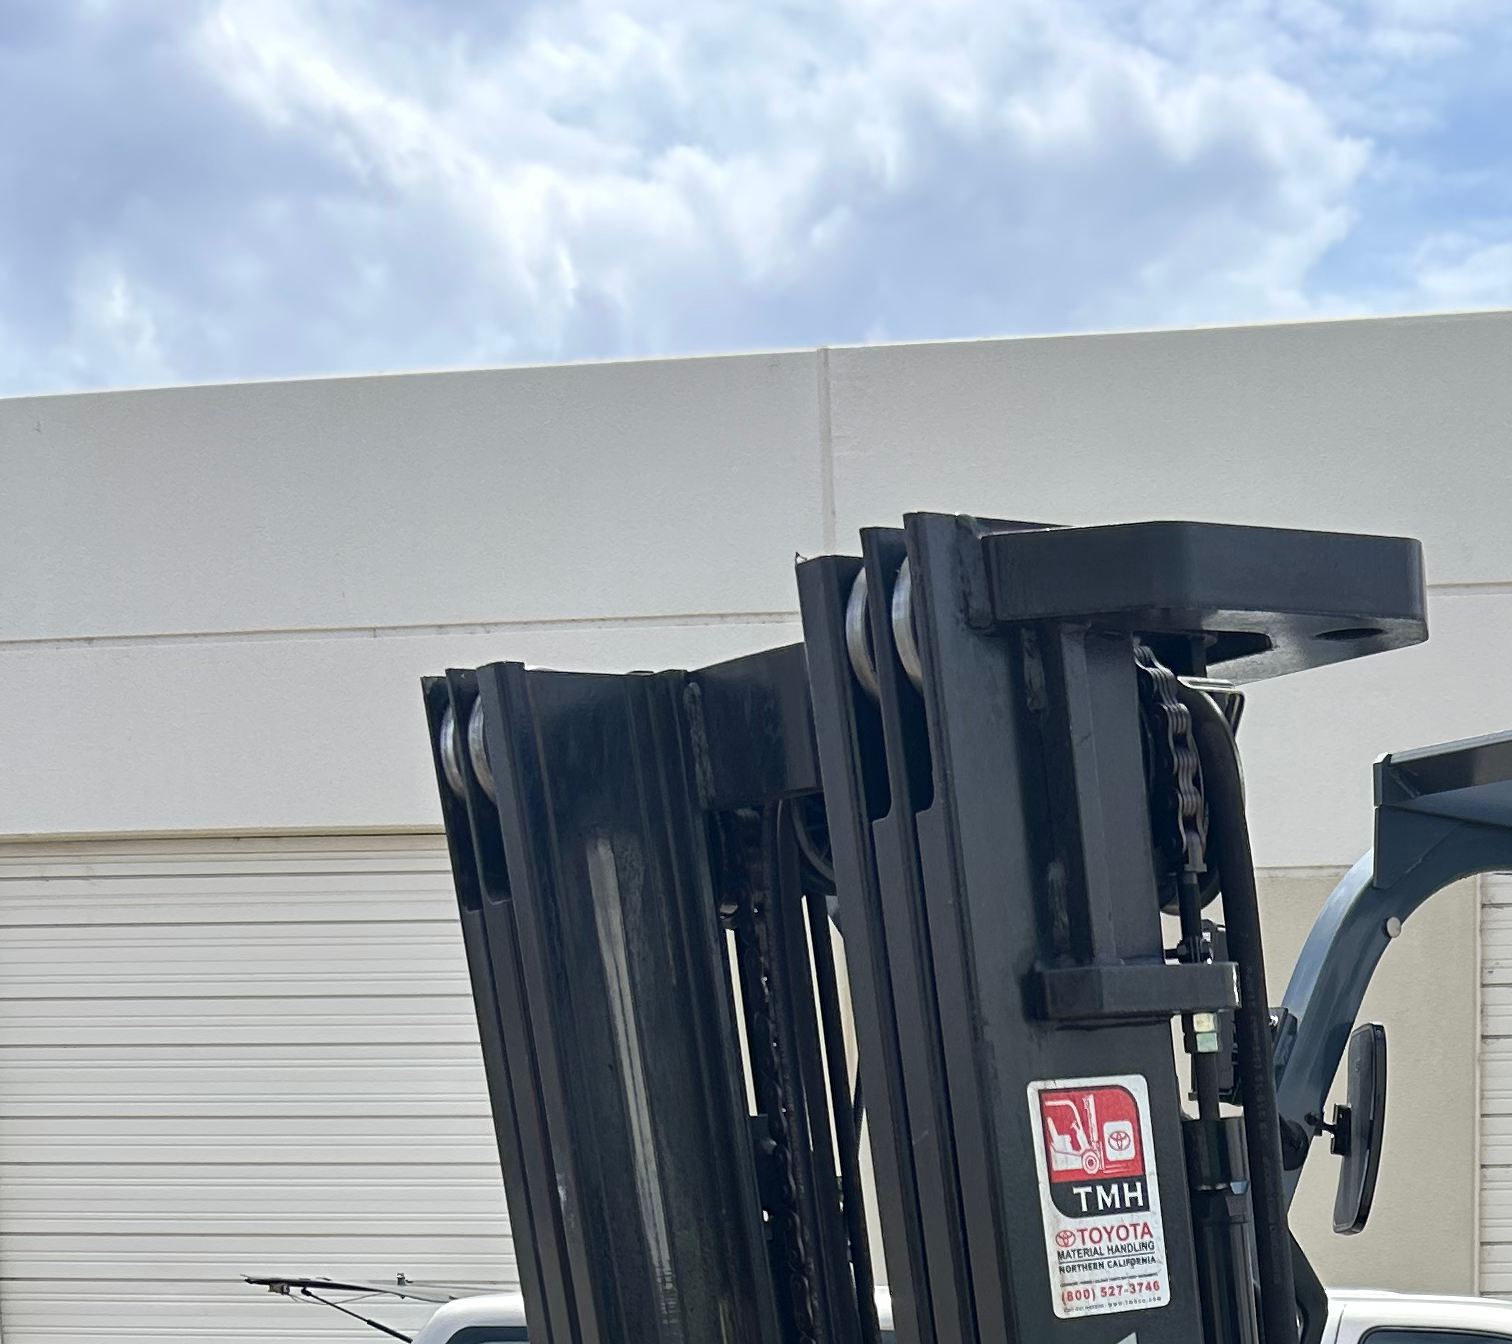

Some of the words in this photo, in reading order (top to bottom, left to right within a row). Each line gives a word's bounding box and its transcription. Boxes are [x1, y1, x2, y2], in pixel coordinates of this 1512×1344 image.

[1073, 1181, 1144, 1213] TMH
[1077, 1222, 1154, 1246] TOYOTA
[1057, 1246, 1105, 1261] MATERIAL
[1107, 1240, 1156, 1254] HANDLING
[1058, 1261, 1105, 1275] NORTHERN
[1107, 1255, 1157, 1269] CALIFORNIA
[1061, 1288, 1096, 1306] (800)
